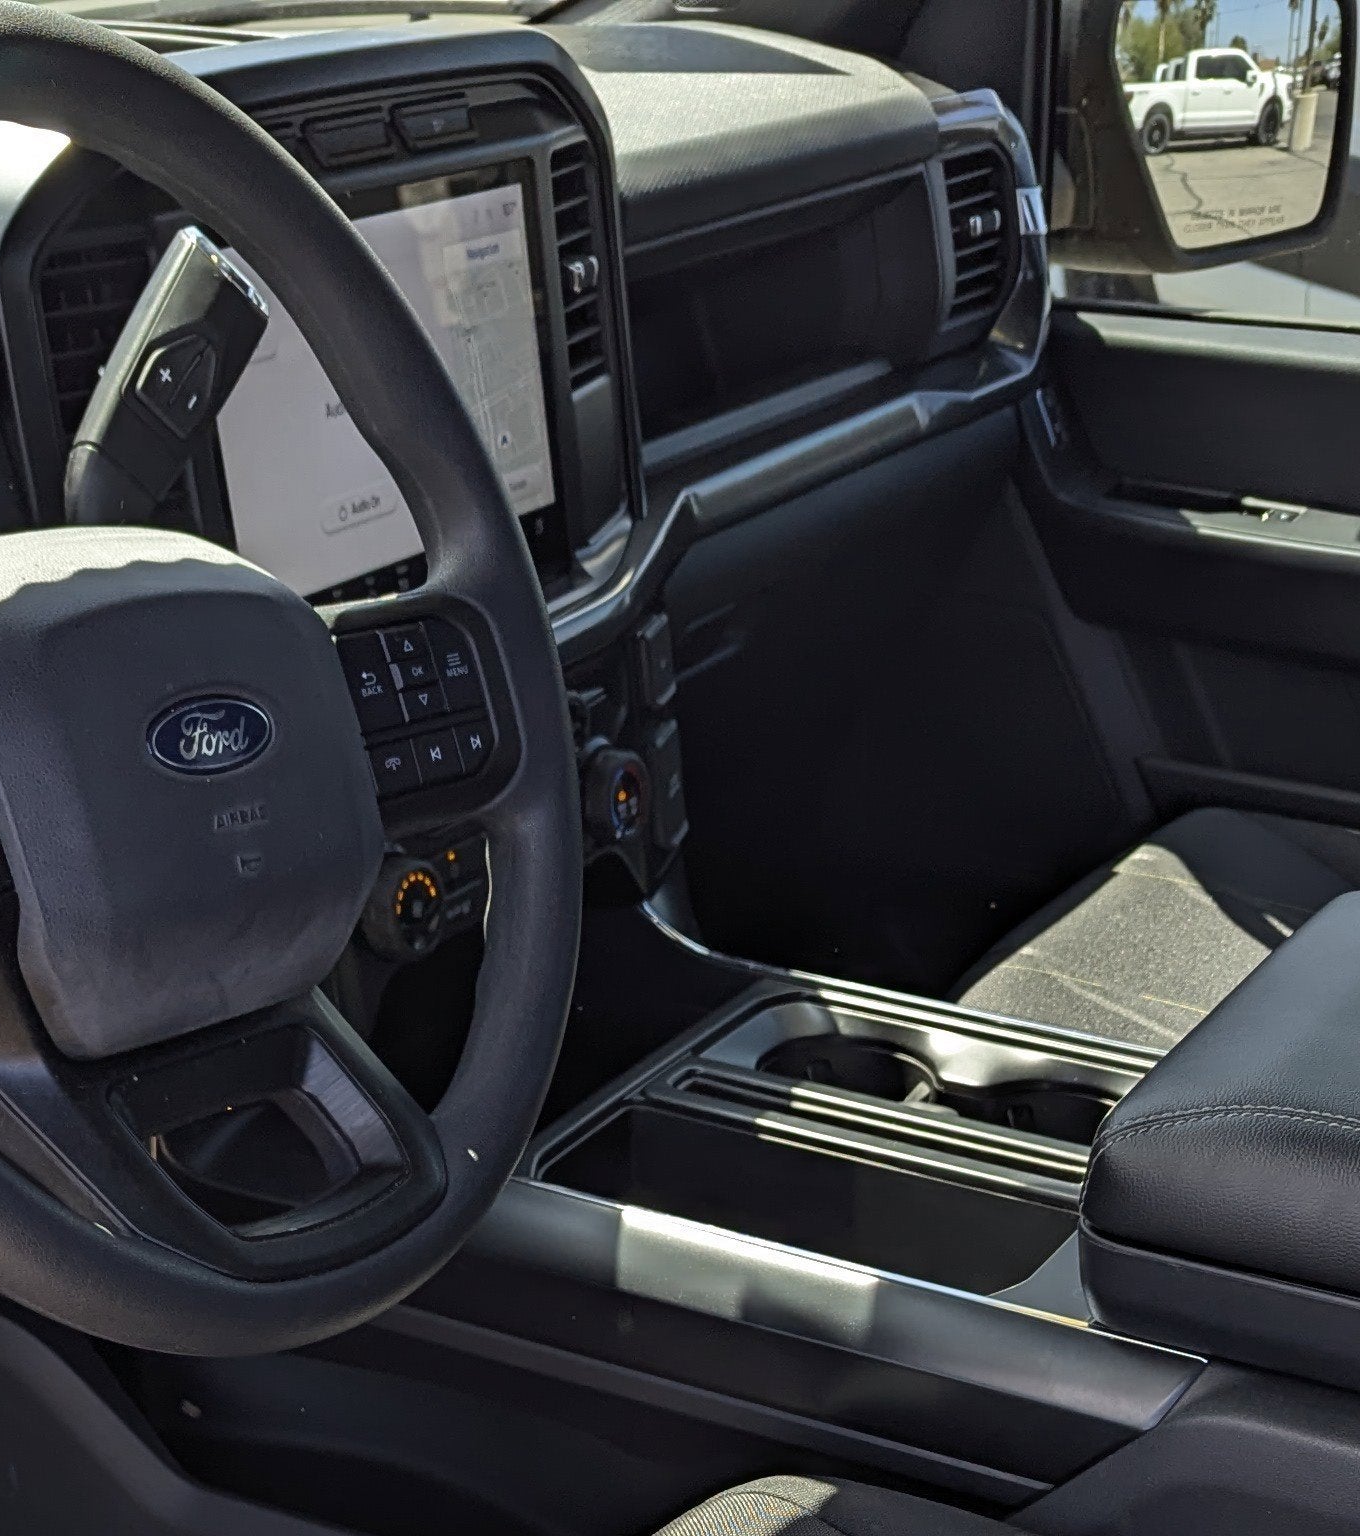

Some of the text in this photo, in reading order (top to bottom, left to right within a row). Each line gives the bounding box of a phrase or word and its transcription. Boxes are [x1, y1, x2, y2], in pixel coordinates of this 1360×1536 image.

[411, 665, 425, 677] OK
[445, 664, 470, 678] MENU
[360, 684, 385, 698] BACK
[178, 708, 250, 761] Ford
